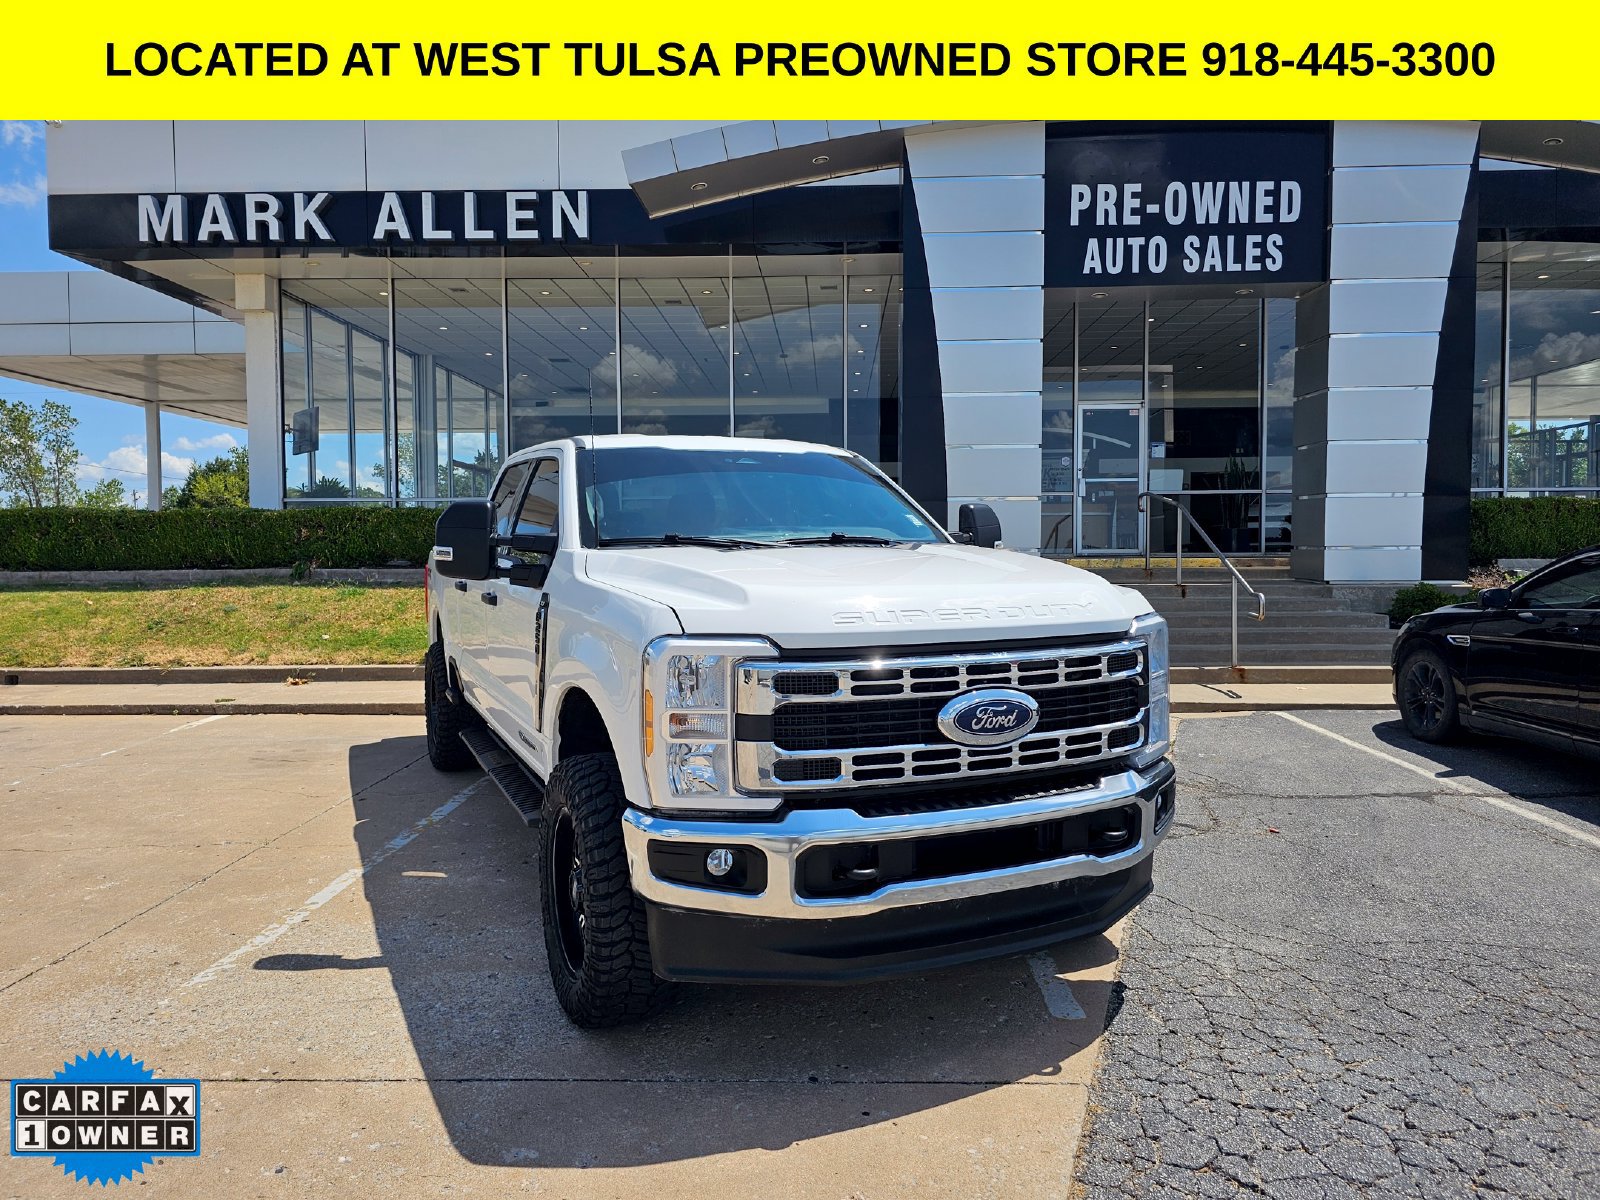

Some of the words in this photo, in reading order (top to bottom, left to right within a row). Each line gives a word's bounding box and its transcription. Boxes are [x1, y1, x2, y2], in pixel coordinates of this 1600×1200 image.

[137, 192, 335, 243] MARK
[373, 190, 589, 241] ALLEN
[1070, 181, 1302, 226] PRE-OWNED
[1083, 236, 1168, 275] AUTO
[1183, 234, 1284, 273] SALES
[832, 607, 992, 627] SUPER
[996, 601, 1093, 620] DUTY
[971, 705, 1018, 730] Ford
